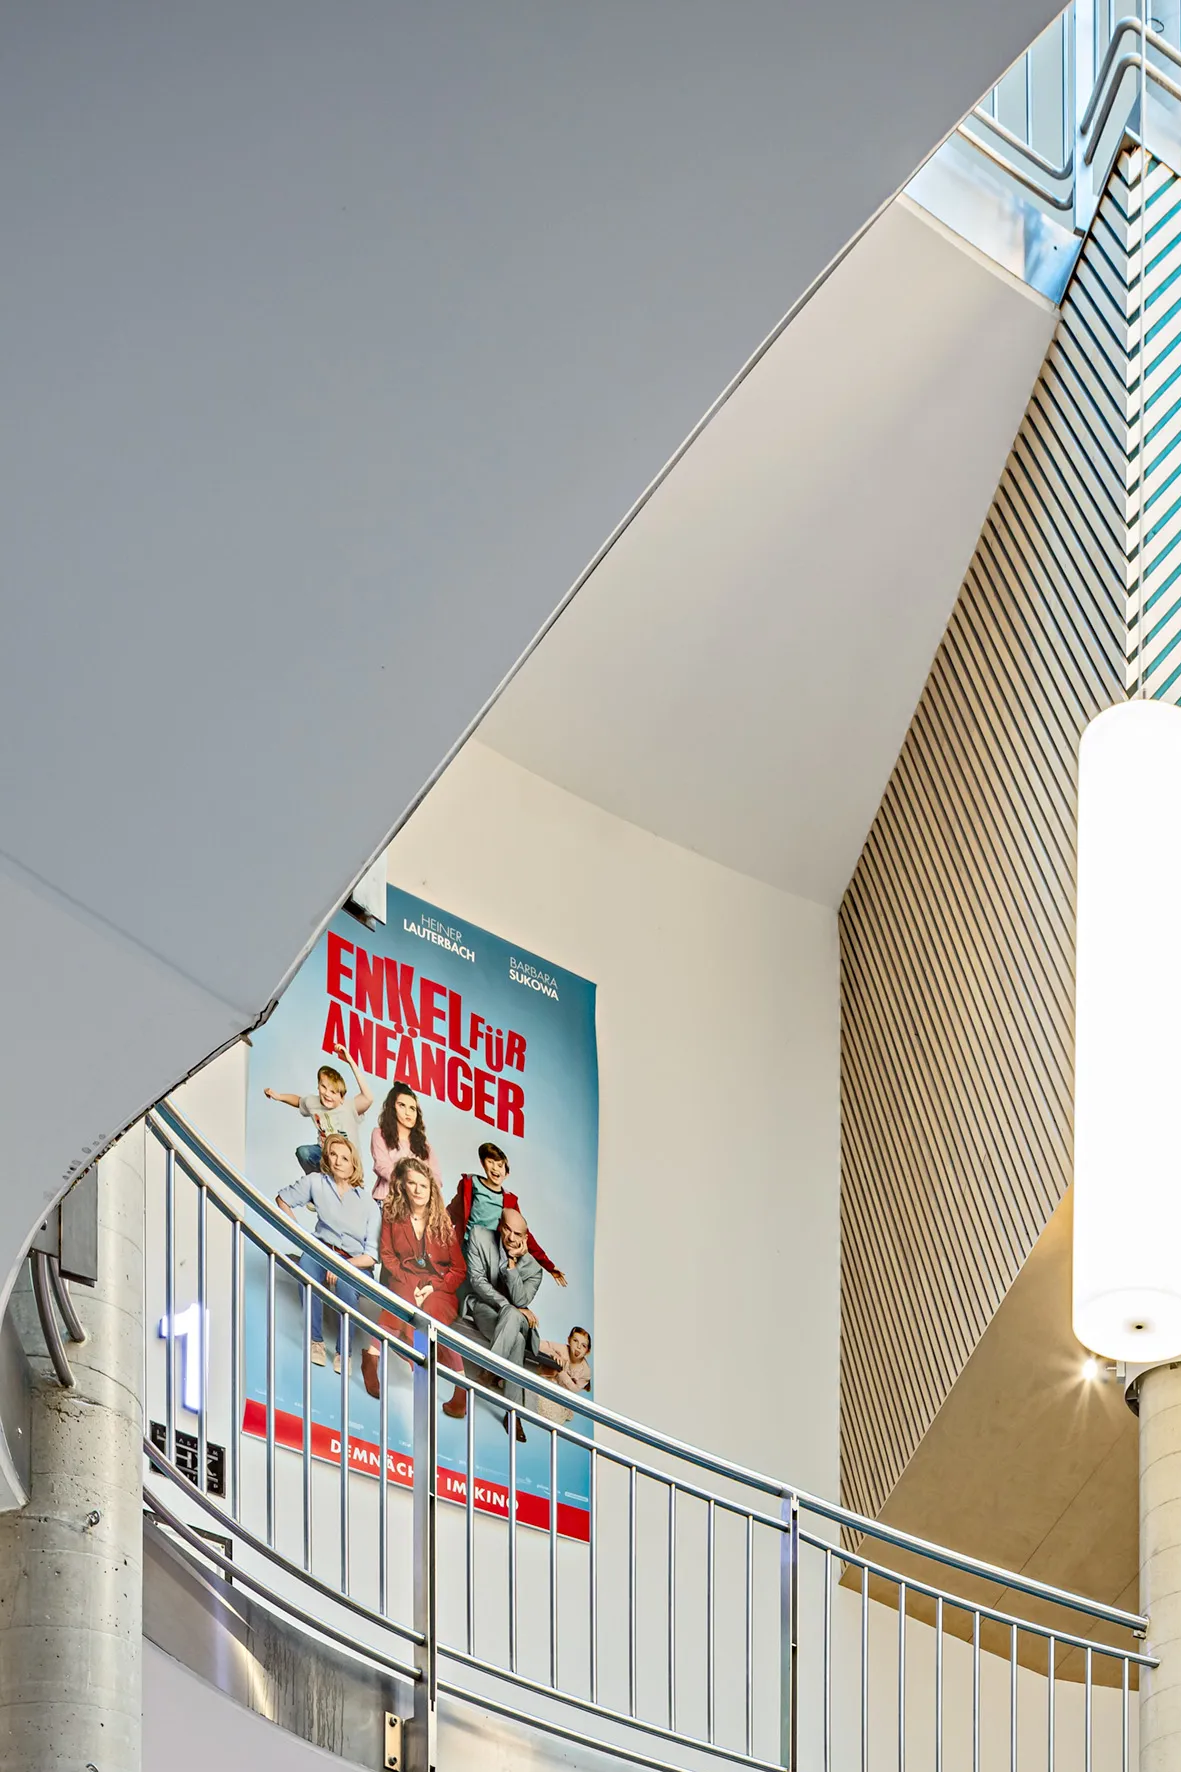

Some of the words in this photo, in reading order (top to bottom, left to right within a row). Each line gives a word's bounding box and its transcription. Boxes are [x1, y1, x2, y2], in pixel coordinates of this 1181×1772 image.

[403, 919, 475, 963] LAUTERBACH
[421, 914, 462, 943] HEINER
[509, 956, 558, 989] BARBARA
[509, 969, 559, 1001] SUKOWA
[327, 930, 471, 1059] ENKEL
[470, 1012, 527, 1073] FÜR
[321, 999, 525, 1139] ANFÄNGER
[159, 1303, 210, 1414] 1
[446, 1478, 467, 1496] IM
